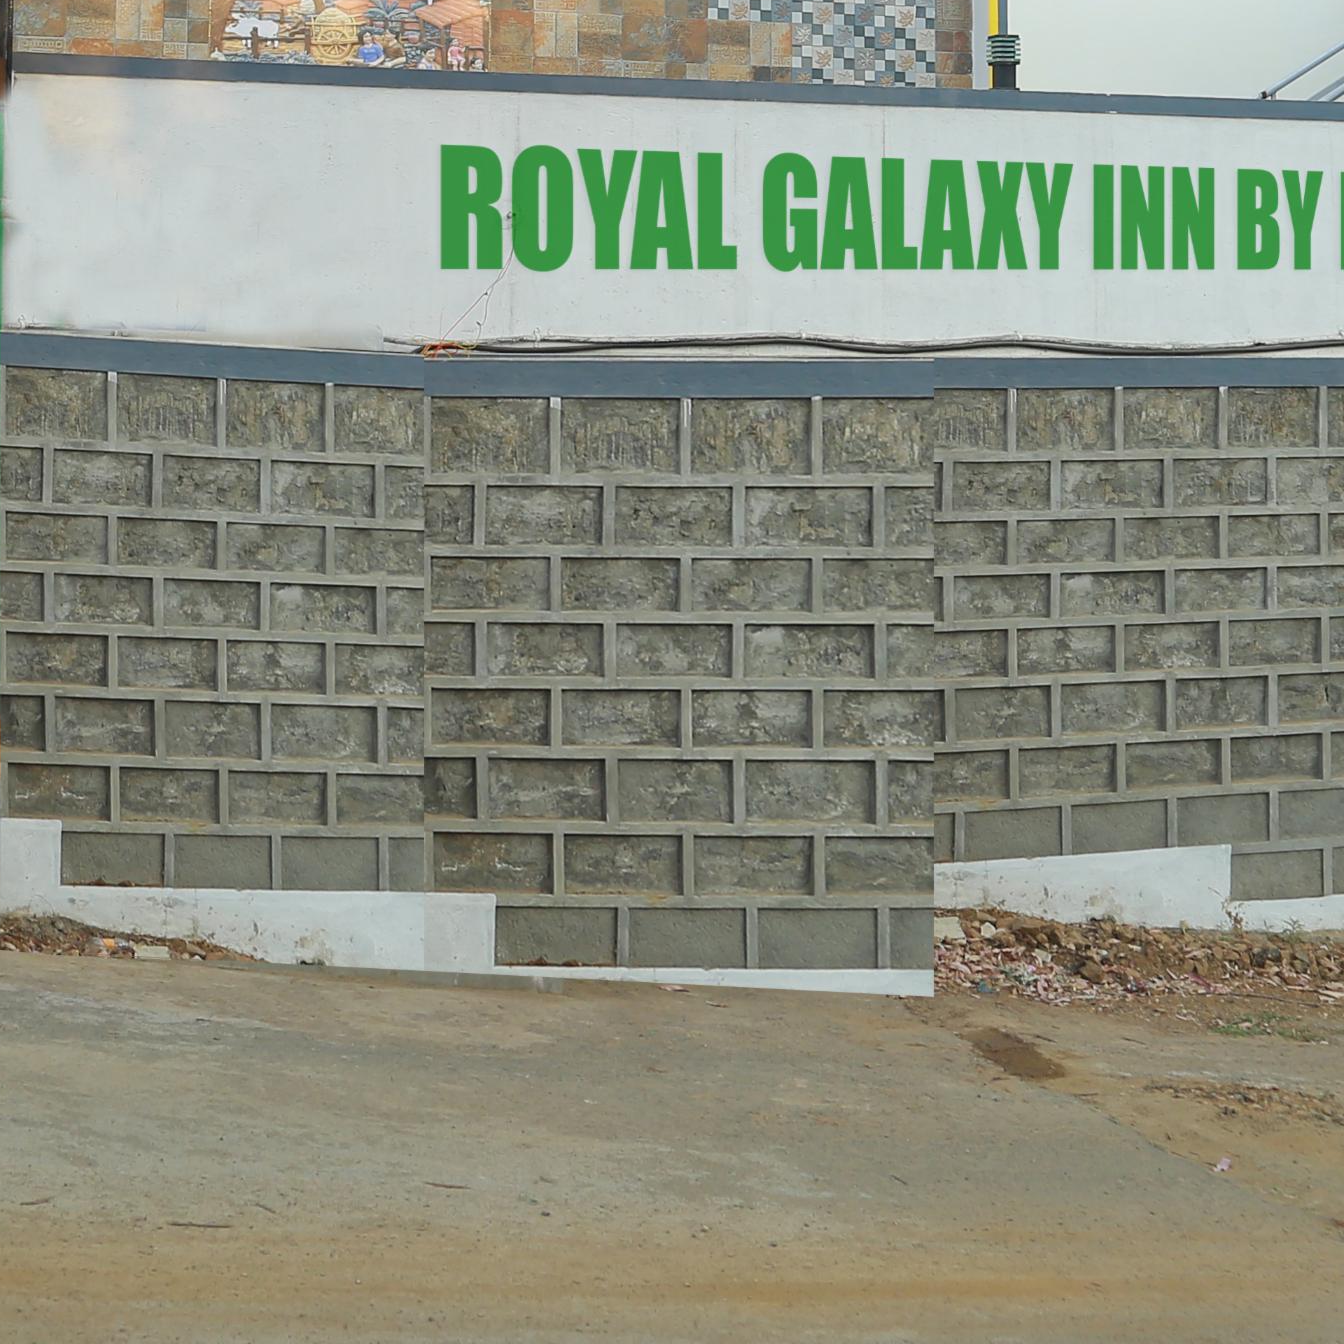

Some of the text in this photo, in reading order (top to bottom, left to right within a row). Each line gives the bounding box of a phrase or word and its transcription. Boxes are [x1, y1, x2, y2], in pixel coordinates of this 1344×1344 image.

[440, 144, 737, 273] ROYAL
[762, 152, 1073, 272] GALAXY
[1093, 164, 1215, 270] INN
[1237, 168, 1323, 270] BY
